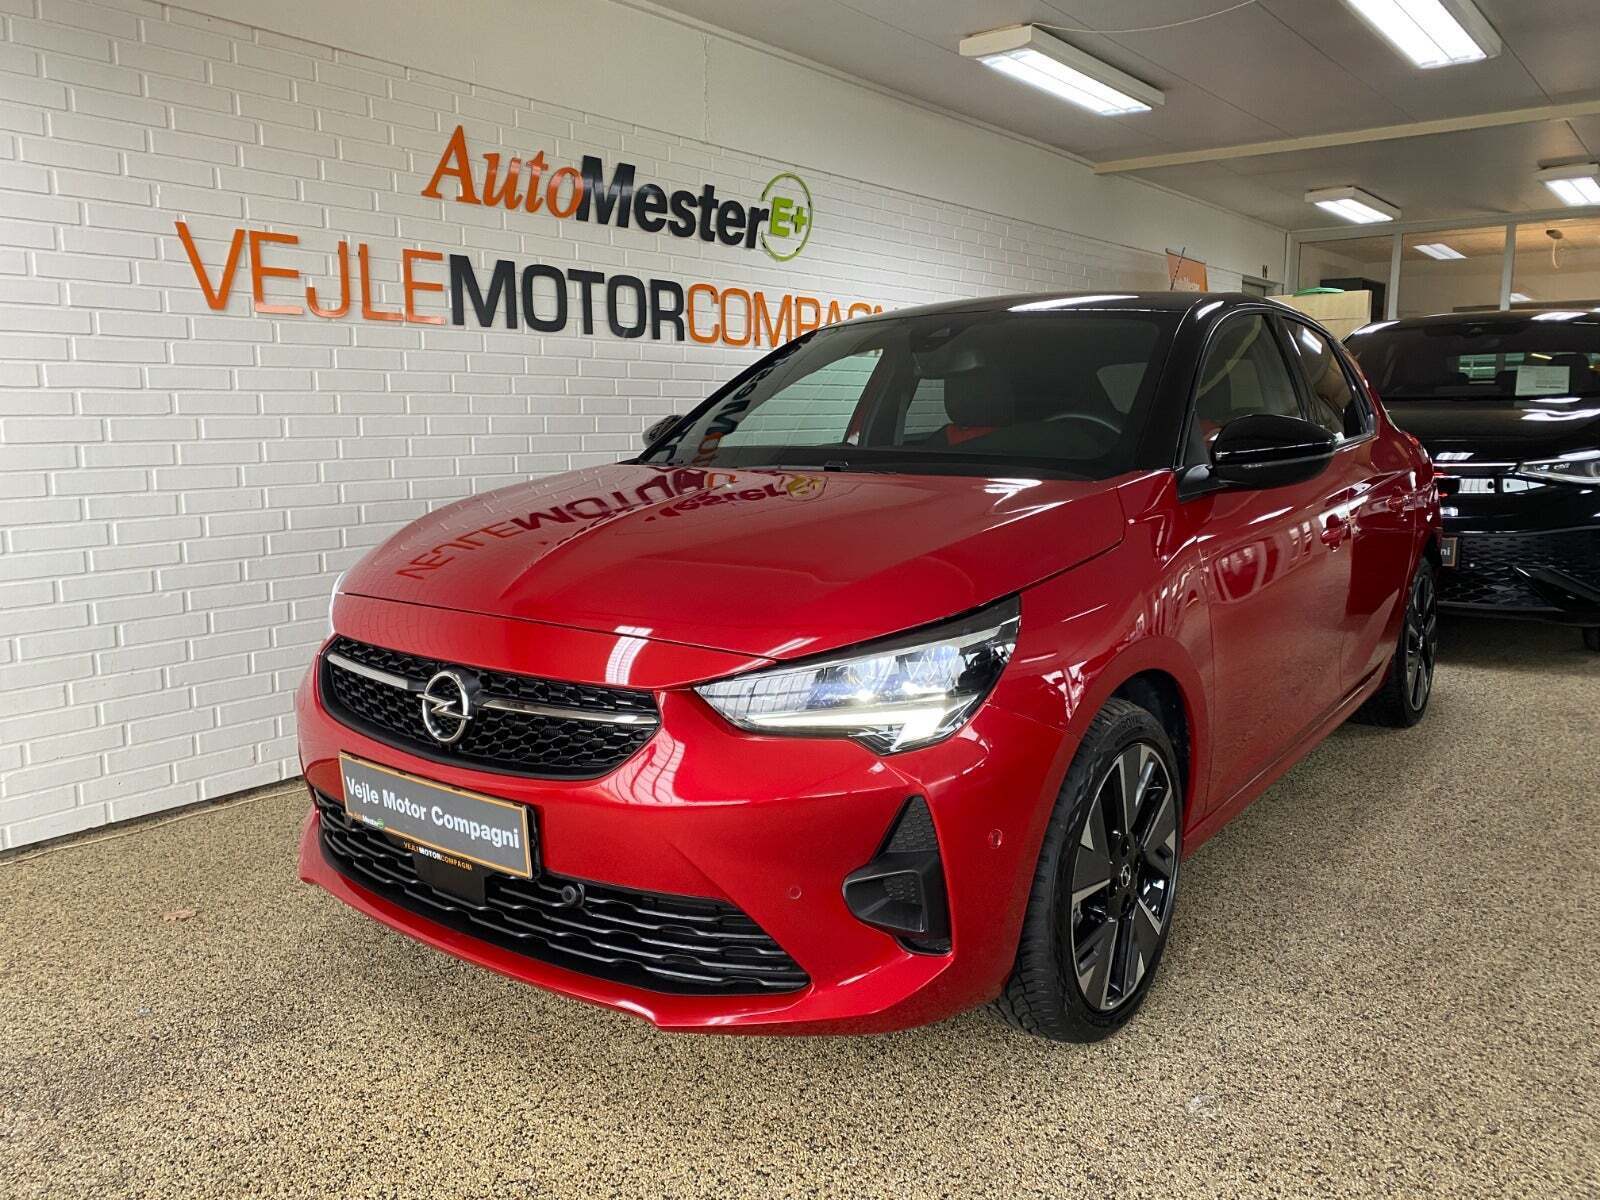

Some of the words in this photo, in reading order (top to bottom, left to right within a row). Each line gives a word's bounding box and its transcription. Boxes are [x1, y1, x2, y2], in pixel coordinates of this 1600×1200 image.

[420, 125, 769, 249] AutoMester
[174, 221, 884, 348] VEJLEMOTORCOMPA
[346, 776, 379, 805] Vejle
[383, 789, 427, 821] Motor
[431, 806, 520, 849] Compagni
